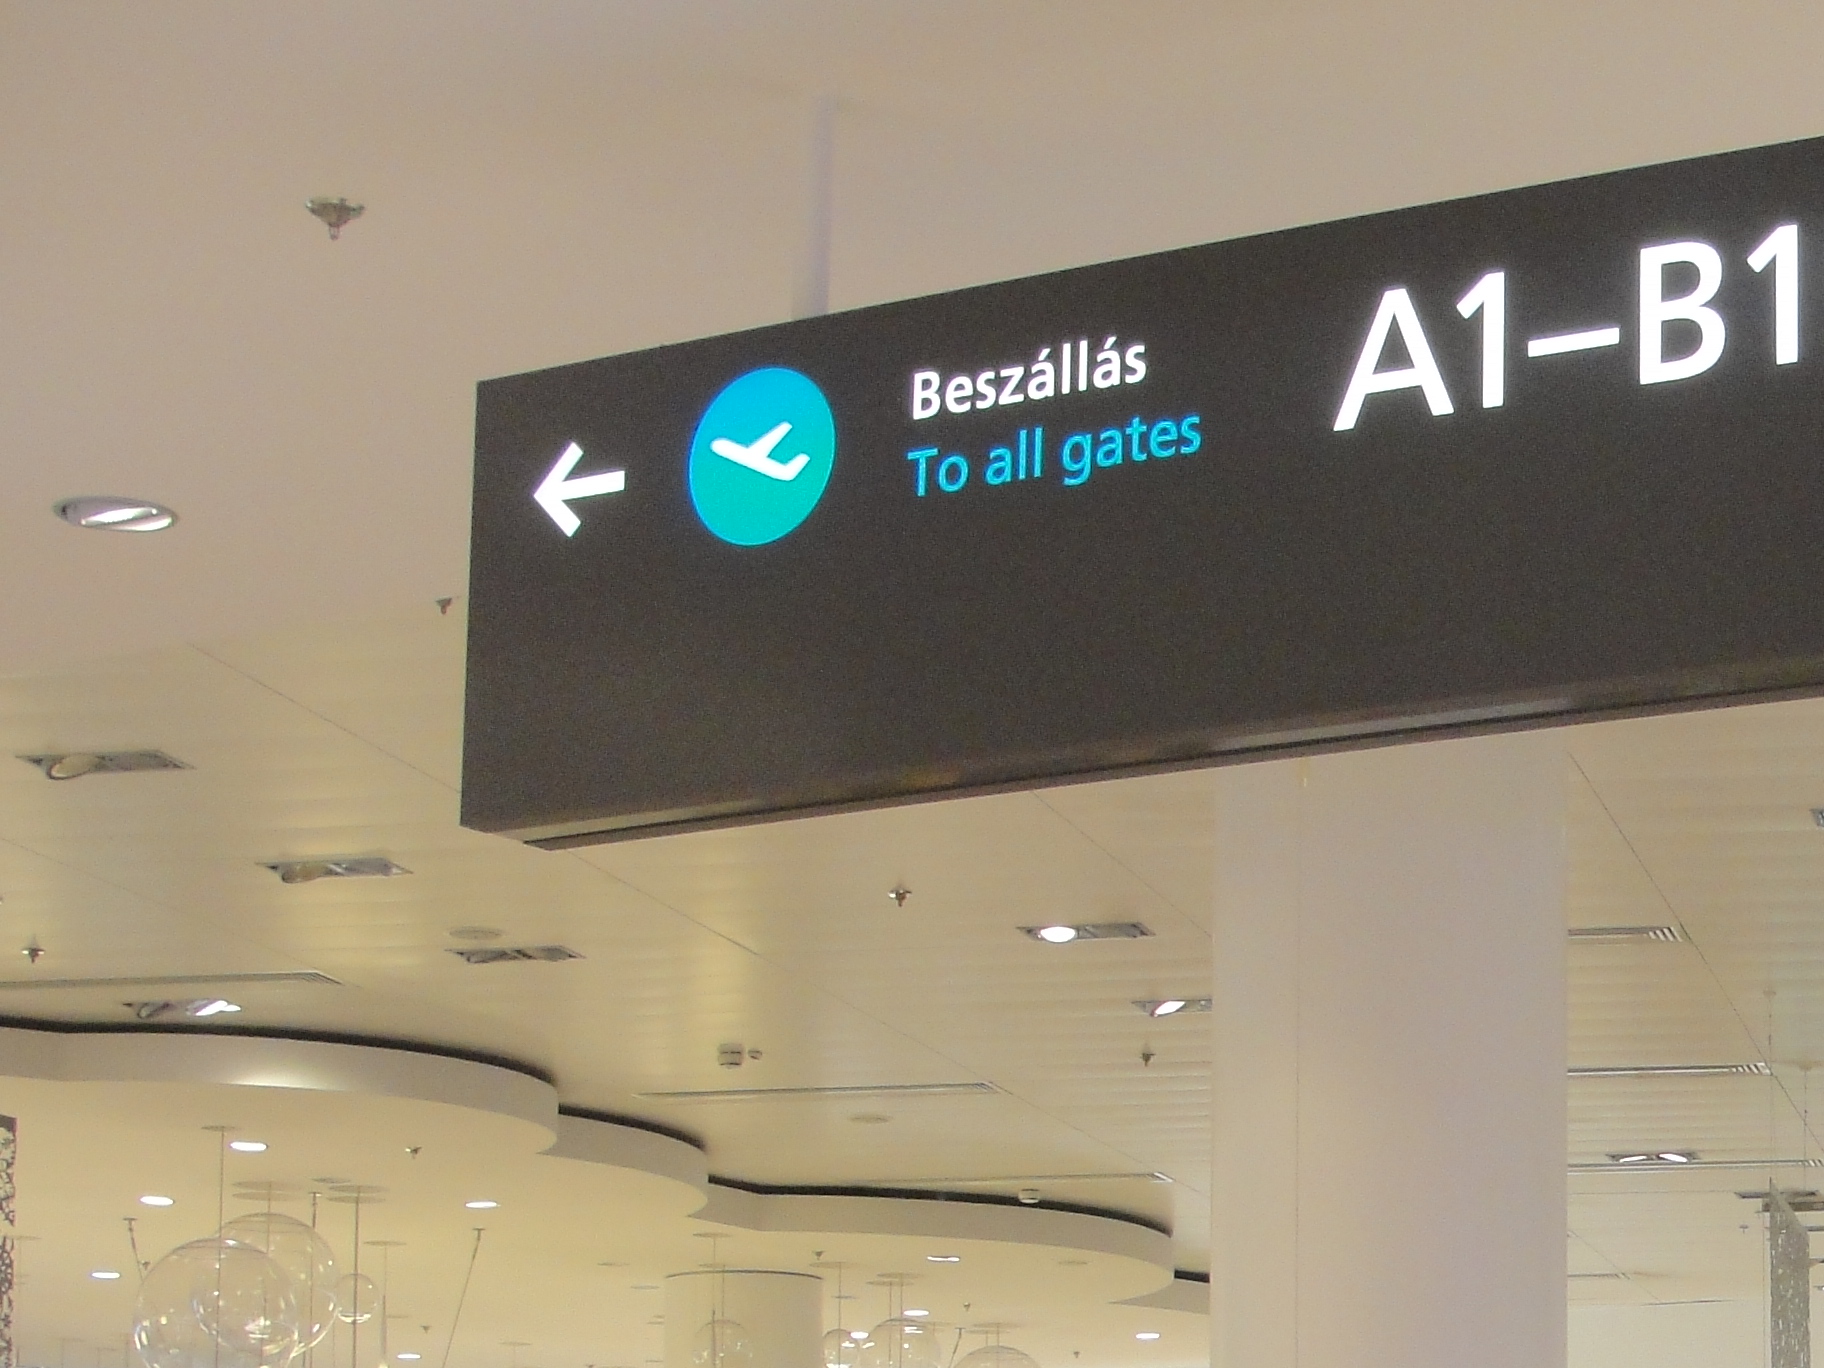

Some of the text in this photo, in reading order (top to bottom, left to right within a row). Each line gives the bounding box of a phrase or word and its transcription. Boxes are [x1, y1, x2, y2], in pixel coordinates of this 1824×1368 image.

[911, 336, 1147, 421] Beszállás
[906, 414, 1203, 497] To all gates
